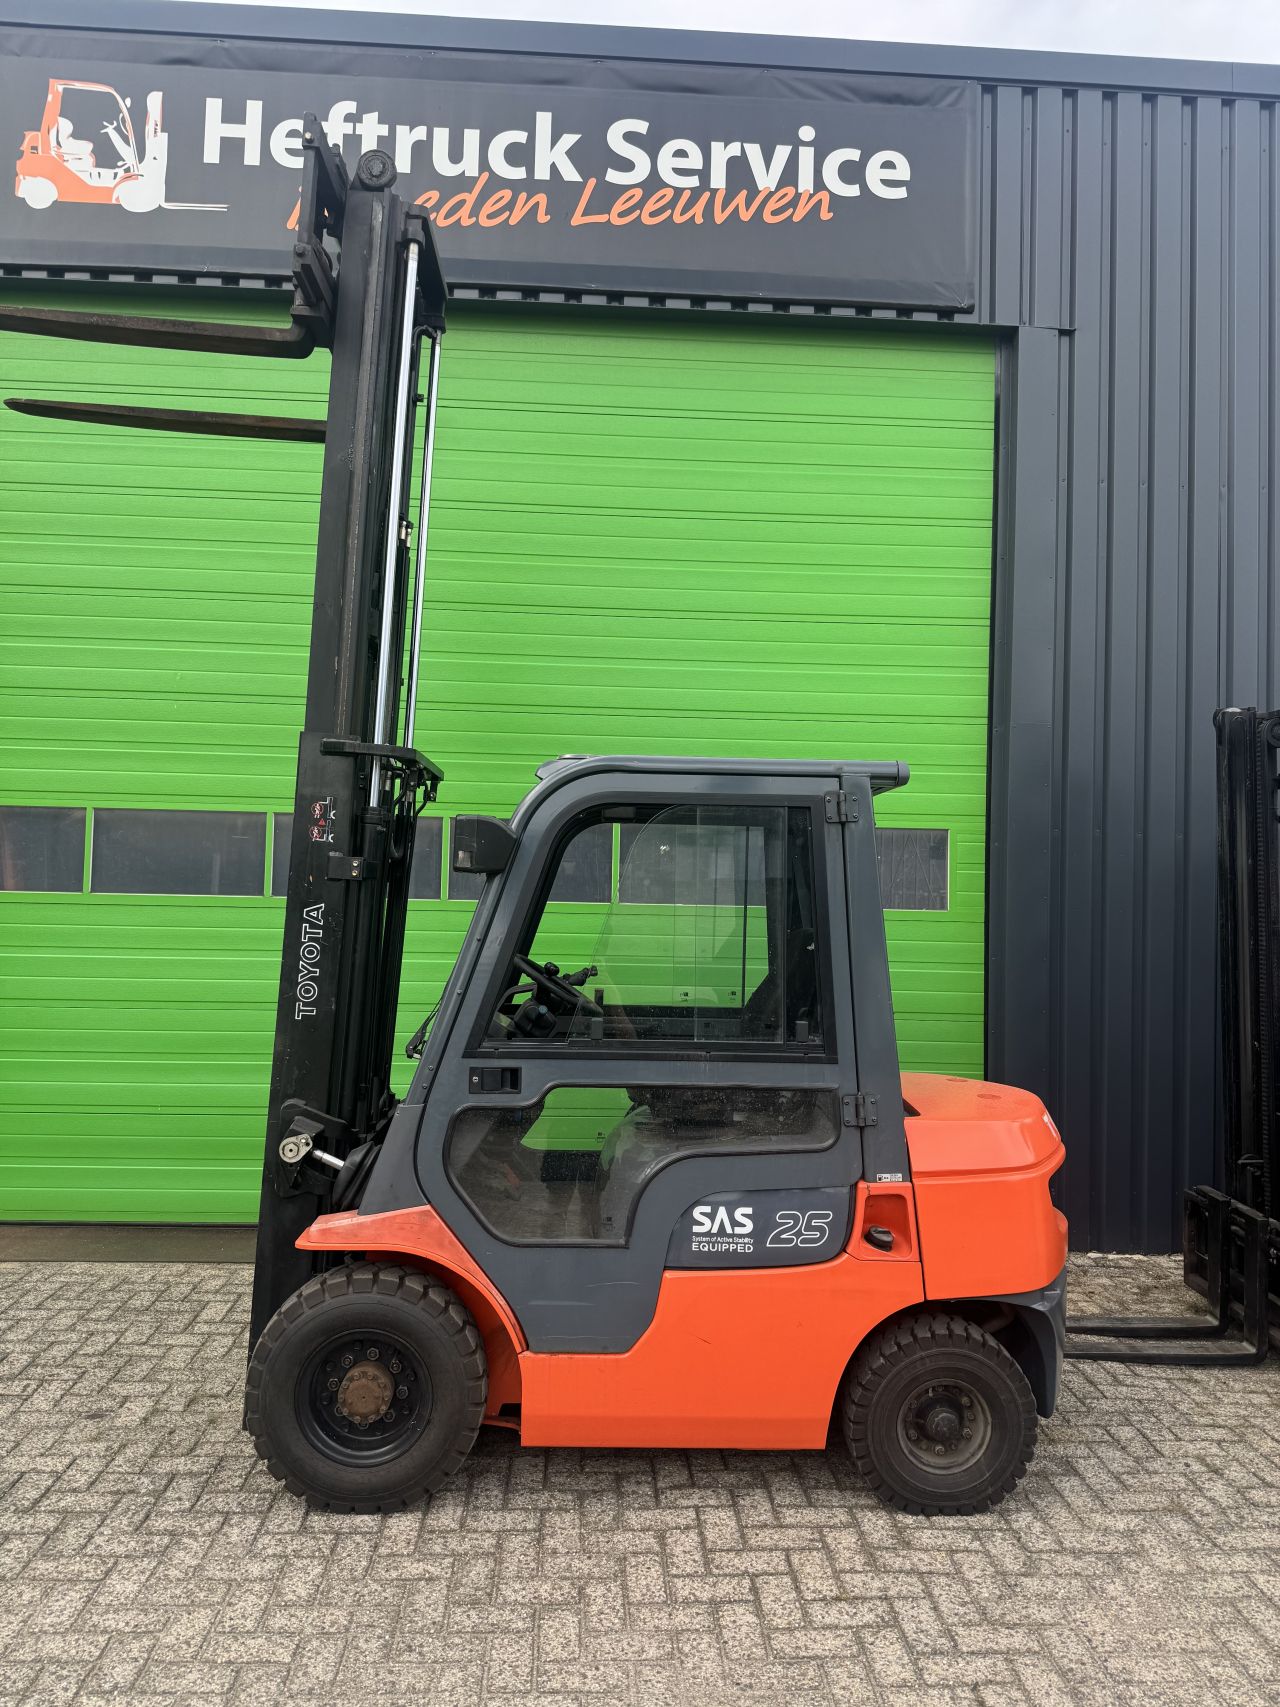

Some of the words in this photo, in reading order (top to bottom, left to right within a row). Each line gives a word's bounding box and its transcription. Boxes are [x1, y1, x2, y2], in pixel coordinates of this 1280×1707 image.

[203, 97, 584, 184] Heftruck
[604, 118, 911, 200] Service
[570, 177, 834, 227] Leeuwen
[295, 903, 325, 1020] TOYOTA
[692, 1205, 754, 1235] SAS
[766, 1210, 833, 1247] 25
[692, 1242, 754, 1253] EQUIPPED
